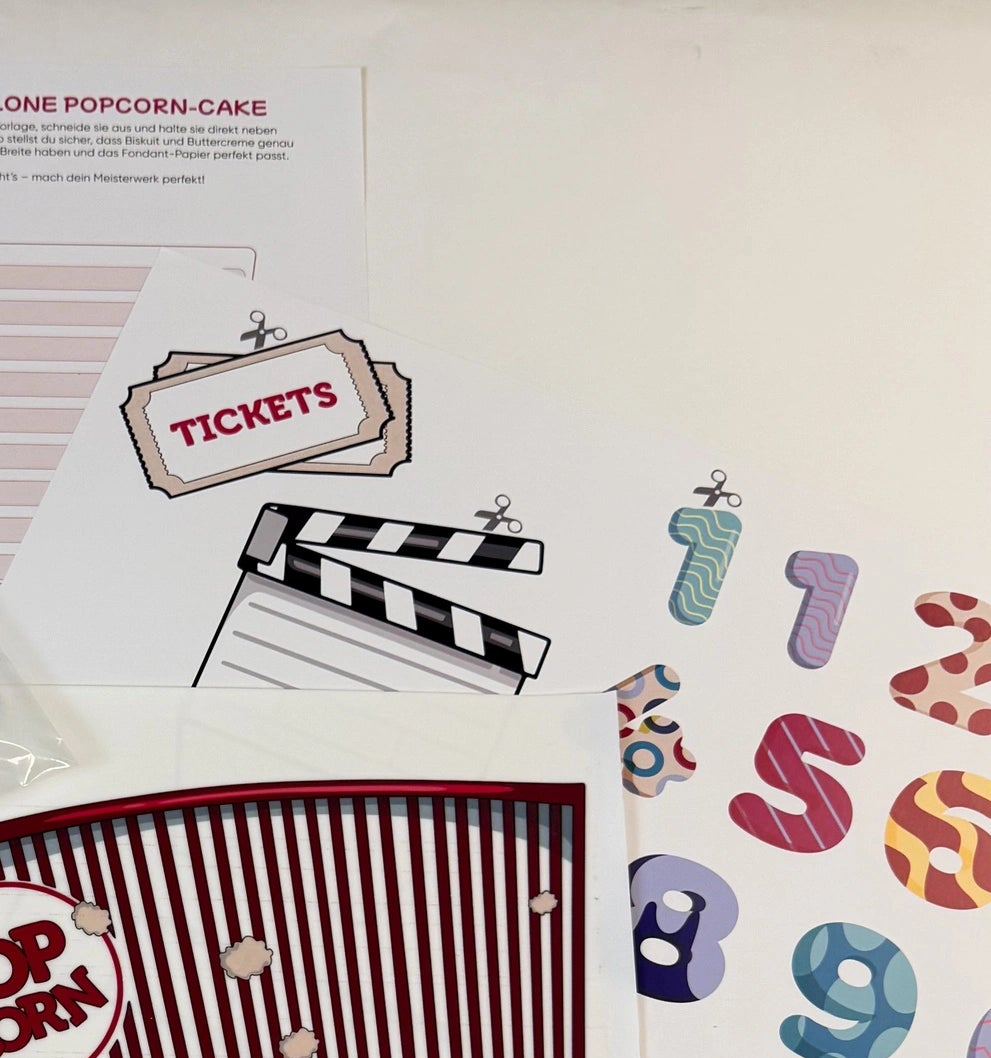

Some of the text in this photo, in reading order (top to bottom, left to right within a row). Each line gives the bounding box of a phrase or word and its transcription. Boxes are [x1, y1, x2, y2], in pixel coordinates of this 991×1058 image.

[7, 135, 38, 144] stellst
[41, 135, 56, 144] du
[59, 136, 93, 146] sicher,
[96, 136, 122, 146] dass
[125, 137, 160, 146] Biskuit
[162, 138, 184, 146] und
[188, 138, 255, 148] Buttercreme
[258, 140, 294, 149] genau
[41, 122, 90, 132] schneide
[94, 123, 108, 133] sie
[112, 125, 132, 134] aus
[134, 124, 156, 134] und
[159, 124, 186, 134] halte
[190, 124, 204, 134] sie
[208, 126, 238, 135] direkt
[242, 126, 277, 136] neben
[64, 96, 268, 116] POPCORN-CAKE
[0, 147, 32, 156] Breite
[35, 148, 70, 157] haben
[74, 148, 95, 158] und
[98, 149, 119, 158] das
[122, 150, 210, 160] Fondant-Papier
[214, 150, 253, 161] perfekt
[256, 152, 289, 162] passt.
[32, 173, 64, 182] mach
[66, 174, 90, 182] dein
[94, 174, 159, 184] Meisterwerk
[162, 174, 205, 185] perfekt!
[169, 381, 338, 448] TICKETS
[668, 507, 743, 626] 1
[784, 550, 859, 670] 1
[889, 591, 991, 736] 2
[728, 713, 866, 853] 5
[884, 770, 991, 910] 6
[628, 853, 739, 1003] 8
